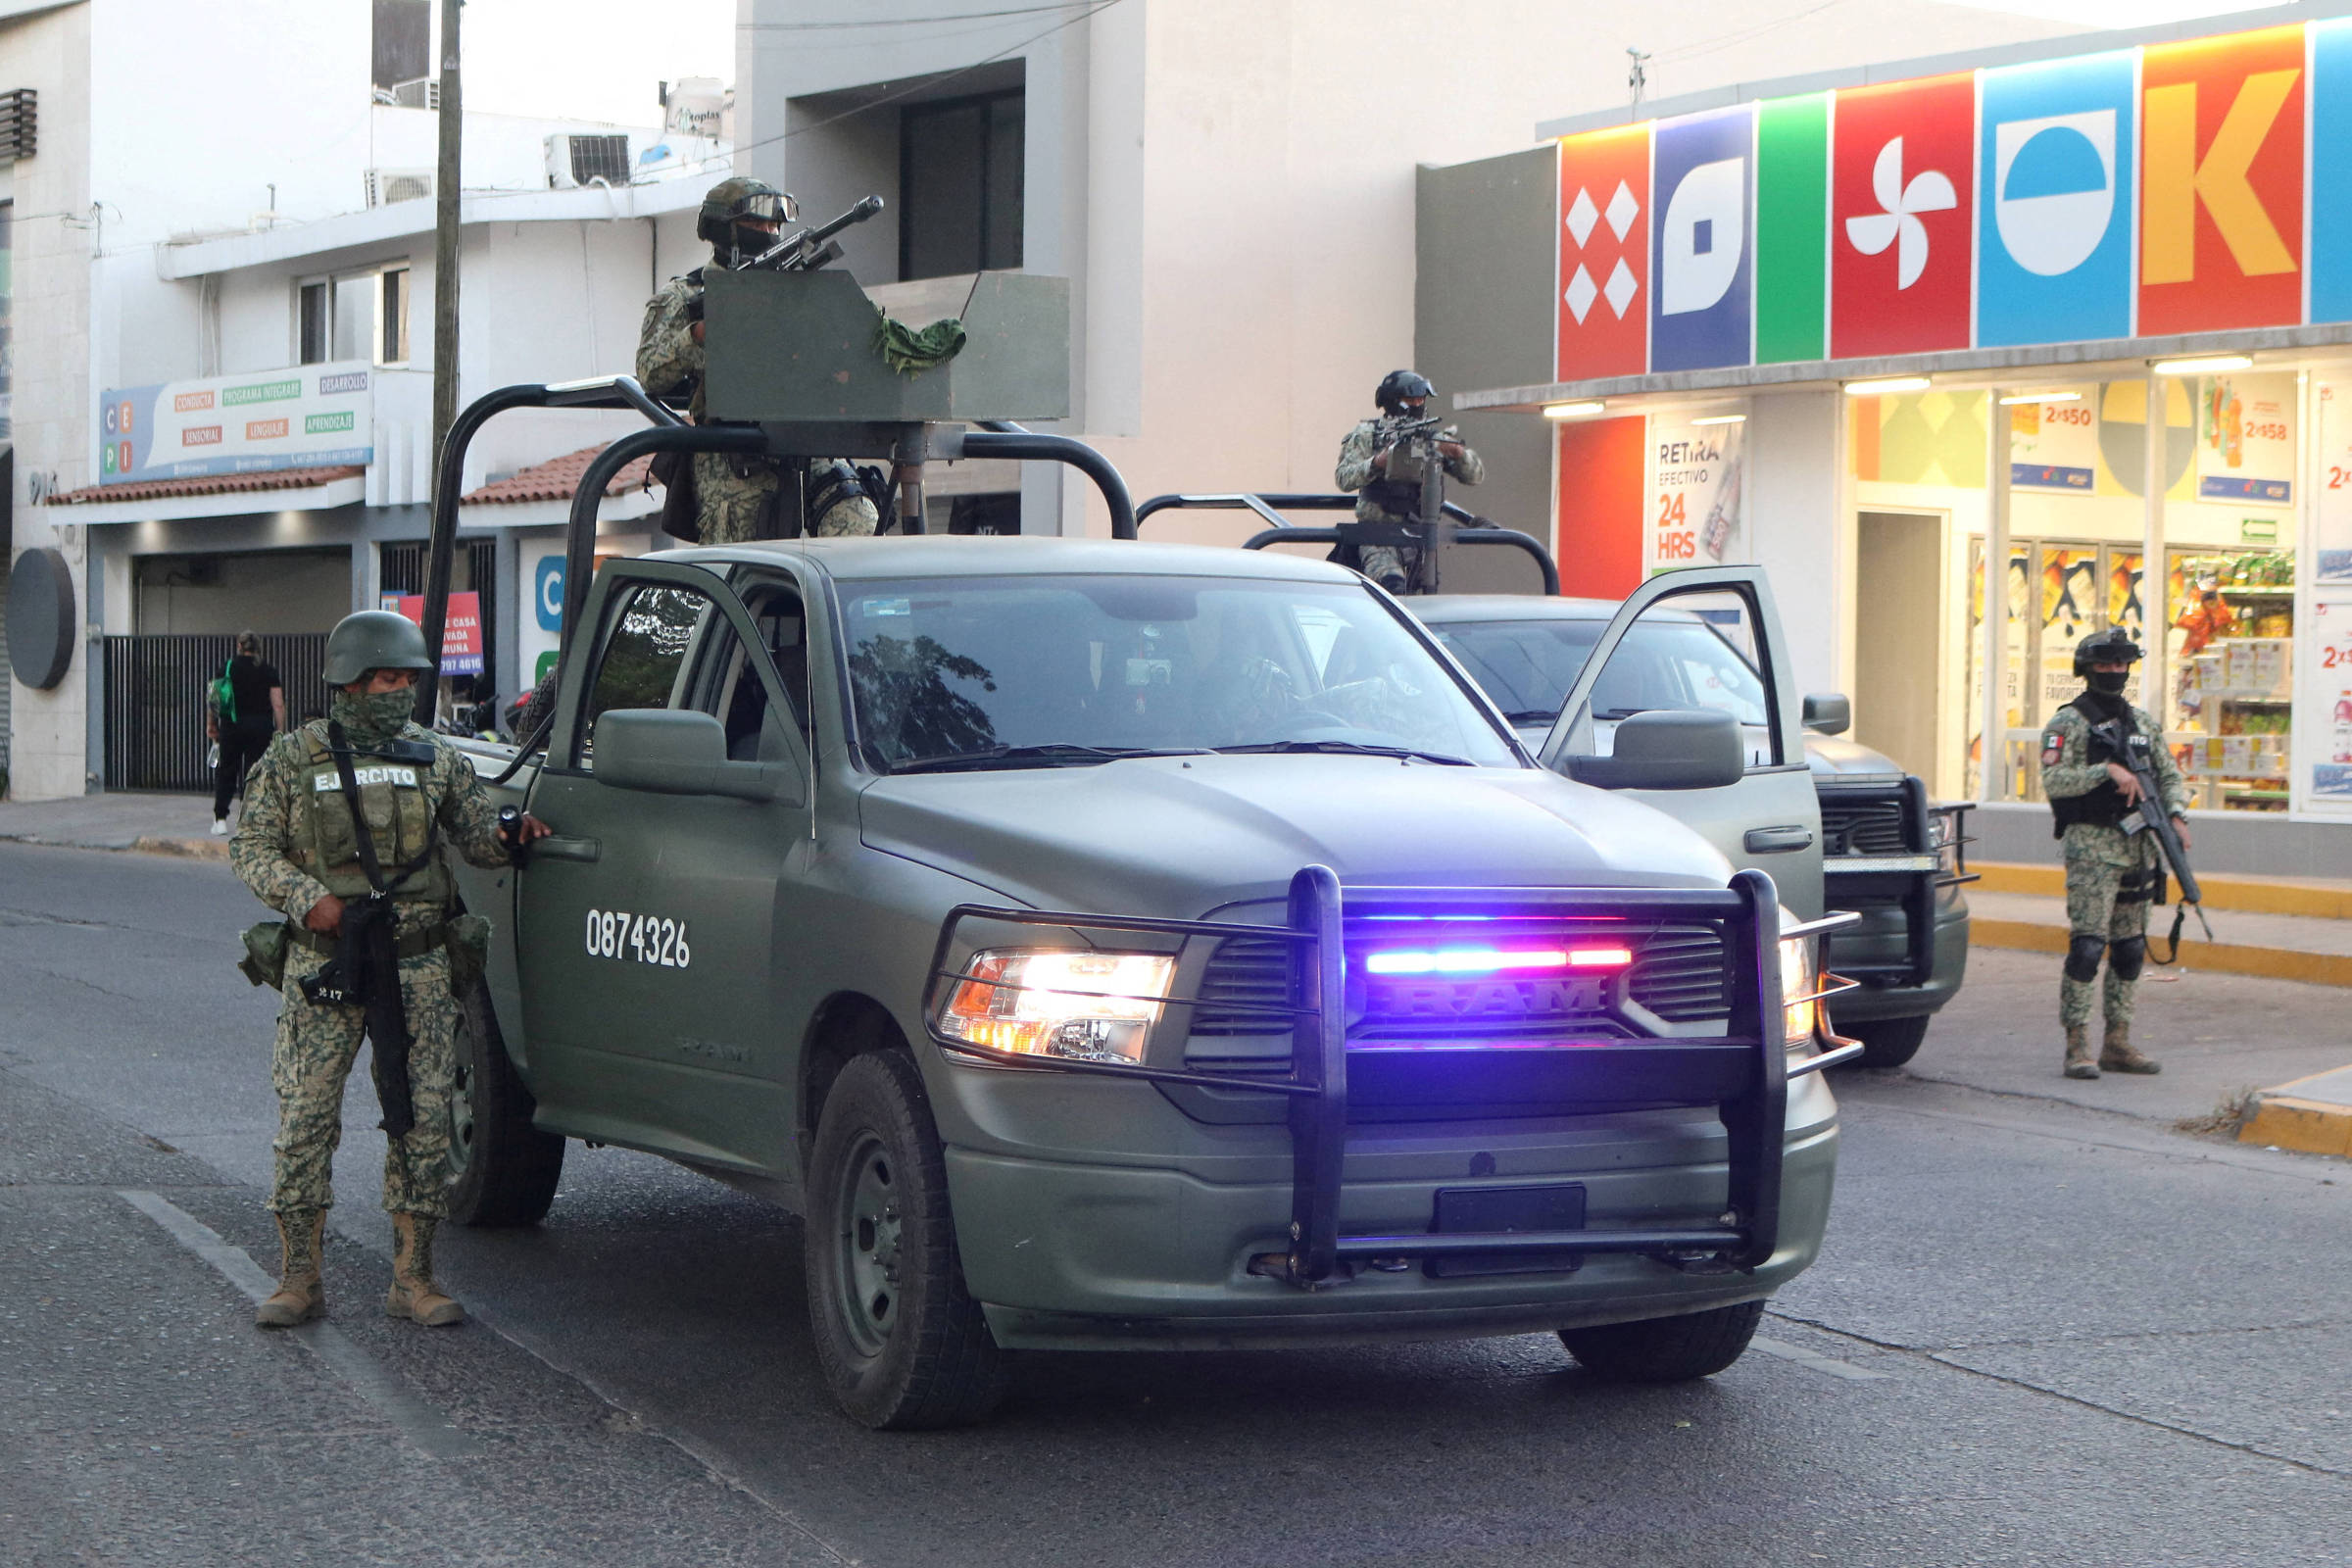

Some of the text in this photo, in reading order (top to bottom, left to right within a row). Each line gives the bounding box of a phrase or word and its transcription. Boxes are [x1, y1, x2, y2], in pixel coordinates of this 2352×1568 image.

[2142, 69, 2301, 285] K
[176, 392, 212, 411] CONDUCTA
[223, 388, 262, 405] PROGRAMA
[320, 374, 367, 391] DESARROLLO
[185, 414, 353, 444] SENSORIAL LENGUAJE APRENDIZAJE
[1660, 441, 1719, 465] RETIRA
[1659, 469, 1708, 486] EFECTIVO
[1658, 492, 1686, 527] 24
[1657, 531, 1695, 560] HRS
[453, 616, 476, 627] CASA
[459, 659, 481, 670] 4616
[316, 766, 416, 791] EJRCITO
[586, 908, 690, 968] 0874326
